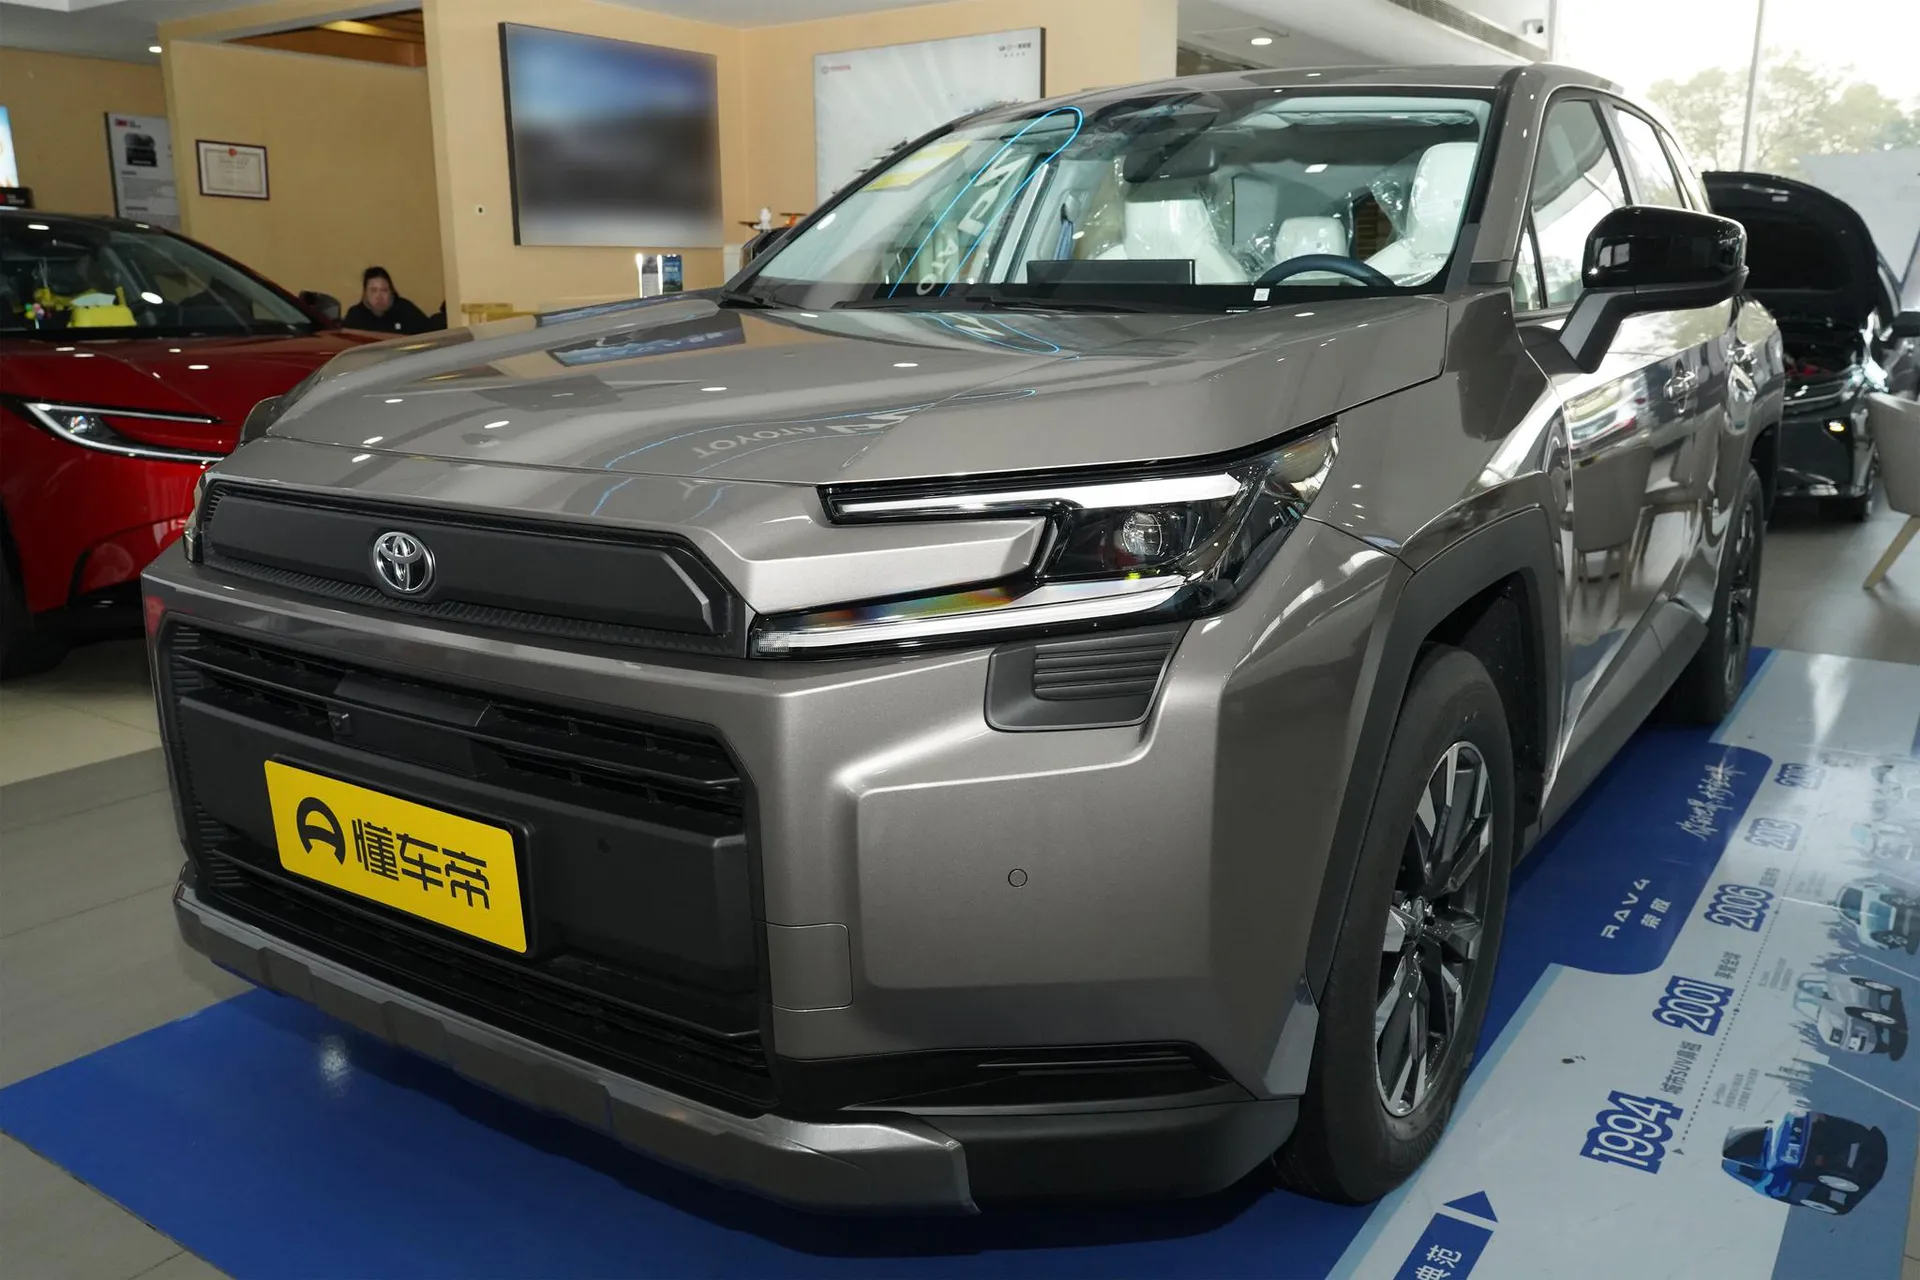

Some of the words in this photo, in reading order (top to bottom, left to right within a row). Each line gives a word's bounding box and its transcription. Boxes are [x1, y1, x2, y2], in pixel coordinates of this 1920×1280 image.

[352, 816, 491, 911] 懂车帝
[1600, 878, 1651, 939] RAV4
[1640, 899, 1672, 930] 荣放
[1707, 886, 1771, 931] 2006
[1658, 978, 1730, 1033] 2001
[1588, 1094, 1675, 1169] 1994
